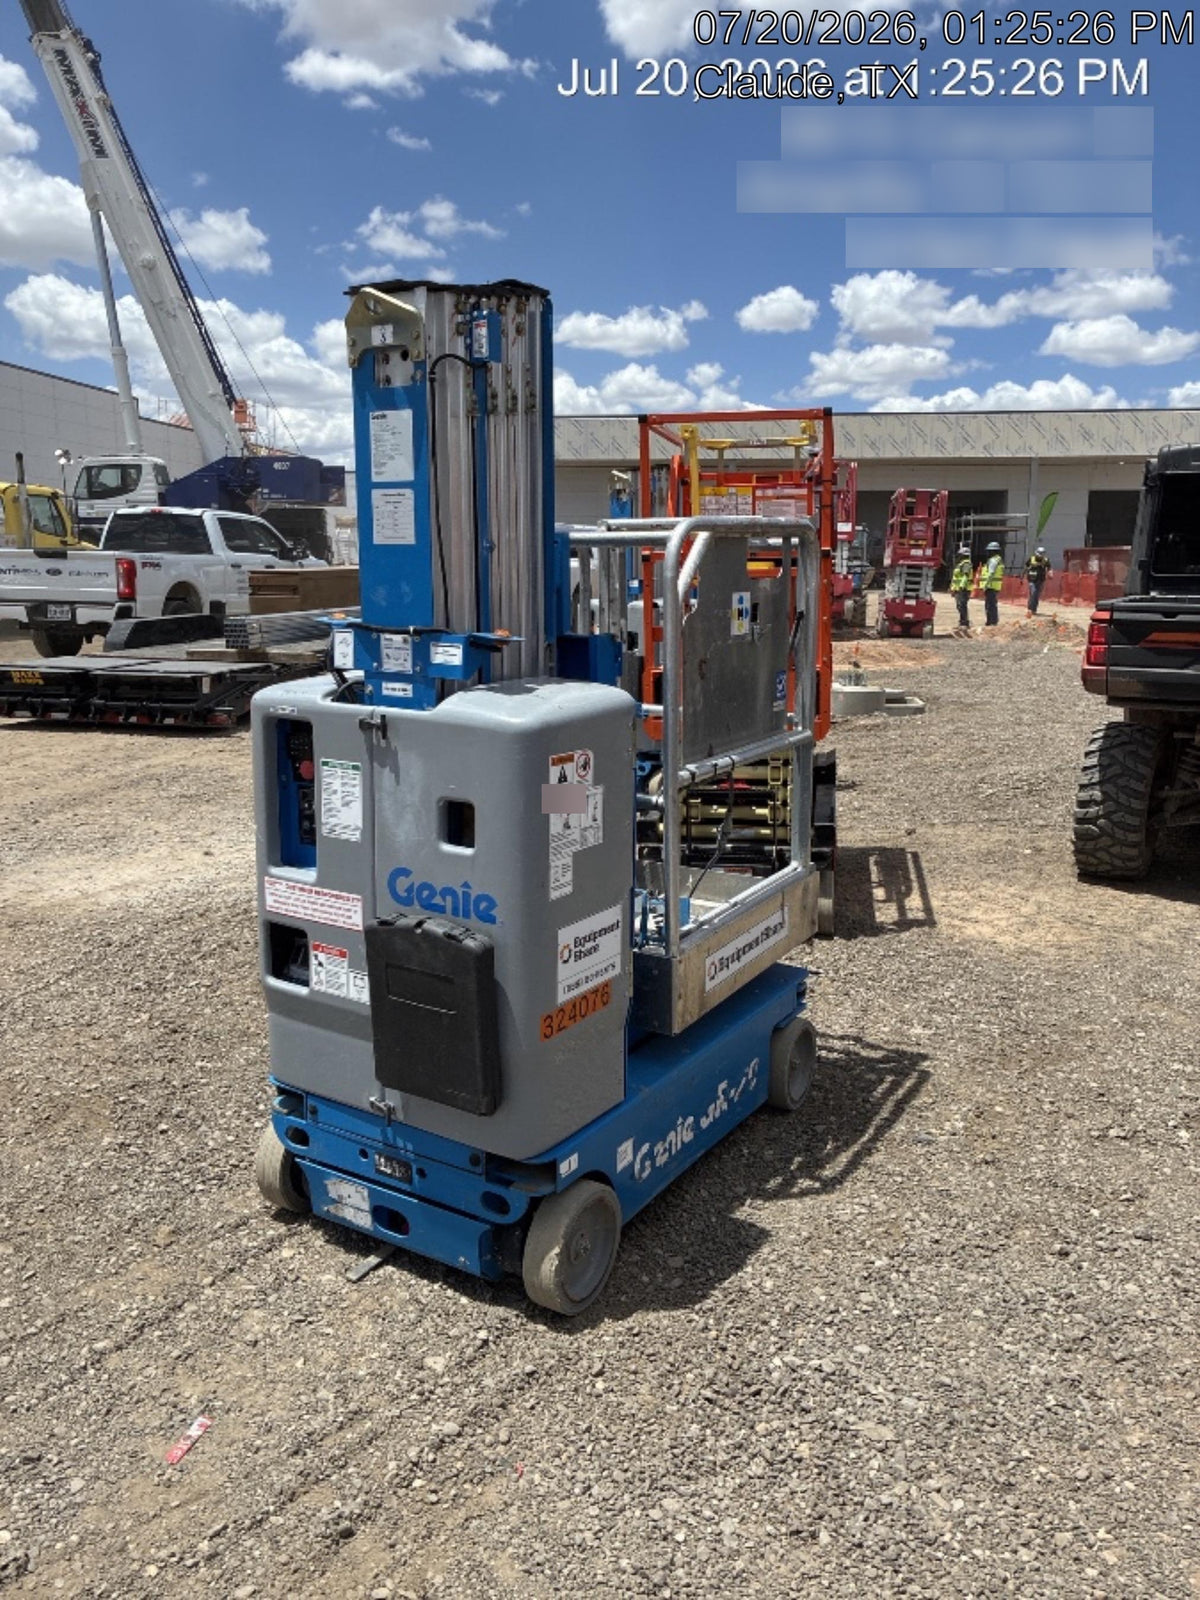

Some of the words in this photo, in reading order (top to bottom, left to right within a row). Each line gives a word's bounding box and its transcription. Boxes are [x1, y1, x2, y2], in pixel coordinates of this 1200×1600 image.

[387, 866, 499, 925] Genie
[573, 919, 621, 949] Equipment
[573, 943, 600, 963] Share
